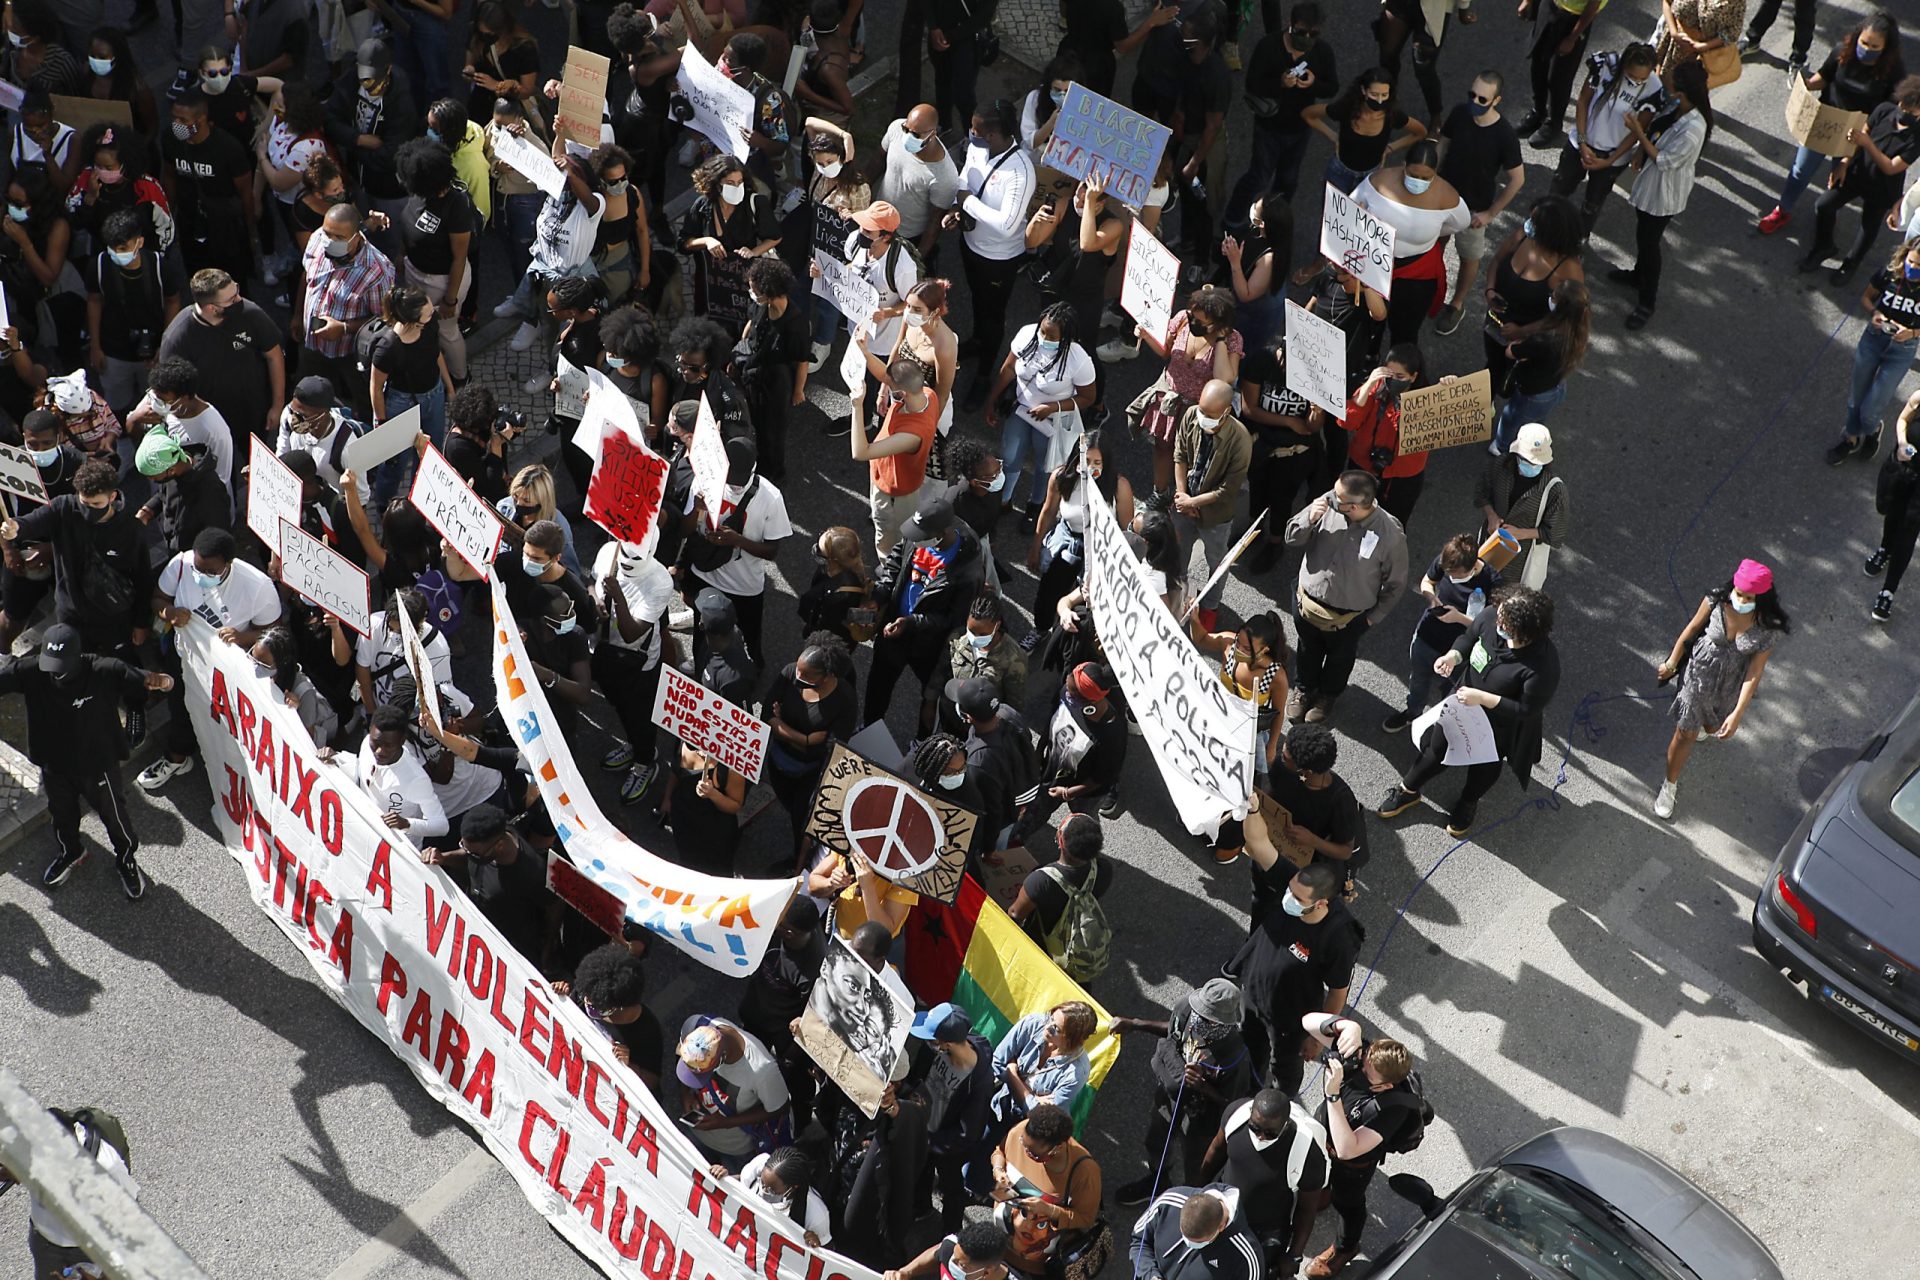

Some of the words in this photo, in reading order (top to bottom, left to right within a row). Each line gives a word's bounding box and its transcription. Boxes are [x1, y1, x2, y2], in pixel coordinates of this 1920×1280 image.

[574, 63, 600, 84] SER
[568, 89, 595, 110] ANTI
[721, 114, 740, 130] VEST
[1078, 94, 1157, 150] BLACK
[1065, 115, 1152, 171] LIVES
[1047, 135, 1147, 202] MATTER
[817, 207, 851, 234] BLACK
[1332, 192, 1347, 217] NO
[1355, 207, 1390, 247] MORE
[1148, 237, 1158, 252] O
[1323, 212, 1391, 273] HASHTAGS
[818, 255, 849, 287] VIDAS
[1292, 332, 1334, 359] ABOUT
[1293, 371, 1344, 409] SCHOOLS
[1404, 393, 1431, 412] QUEM
[1433, 388, 1447, 404] ME
[1403, 411, 1421, 424] QUE
[1422, 407, 1436, 419] AS
[1439, 396, 1480, 416] PESSOAS
[611, 439, 663, 478] STOP
[1401, 436, 1421, 449] COMO
[1423, 430, 1445, 443] AMAM
[602, 447, 661, 505] KILLING
[432, 463, 454, 493] NEM
[458, 490, 487, 529] FALAS
[449, 504, 458, 519] A
[287, 526, 341, 575] BLACK
[287, 545, 325, 580] FACE
[304, 574, 371, 630] RACISMO
[1139, 640, 1158, 678] A
[663, 699, 710, 736] MUDAR
[665, 671, 705, 701] TUDO
[712, 700, 723, 710] O
[731, 708, 762, 733] QUE
[667, 685, 698, 711] NÃO
[749, 738, 762, 753] A
[661, 716, 672, 729] A
[678, 724, 758, 781] ESCOLHER
[209, 667, 344, 857] ABAIXO
[366, 838, 392, 914] A
[424, 881, 661, 1179] VIOLÊNCIA
[220, 762, 355, 984] JUSTIÇA
[376, 950, 496, 1120] PARA
[518, 1099, 722, 1280] CLÁUDI
